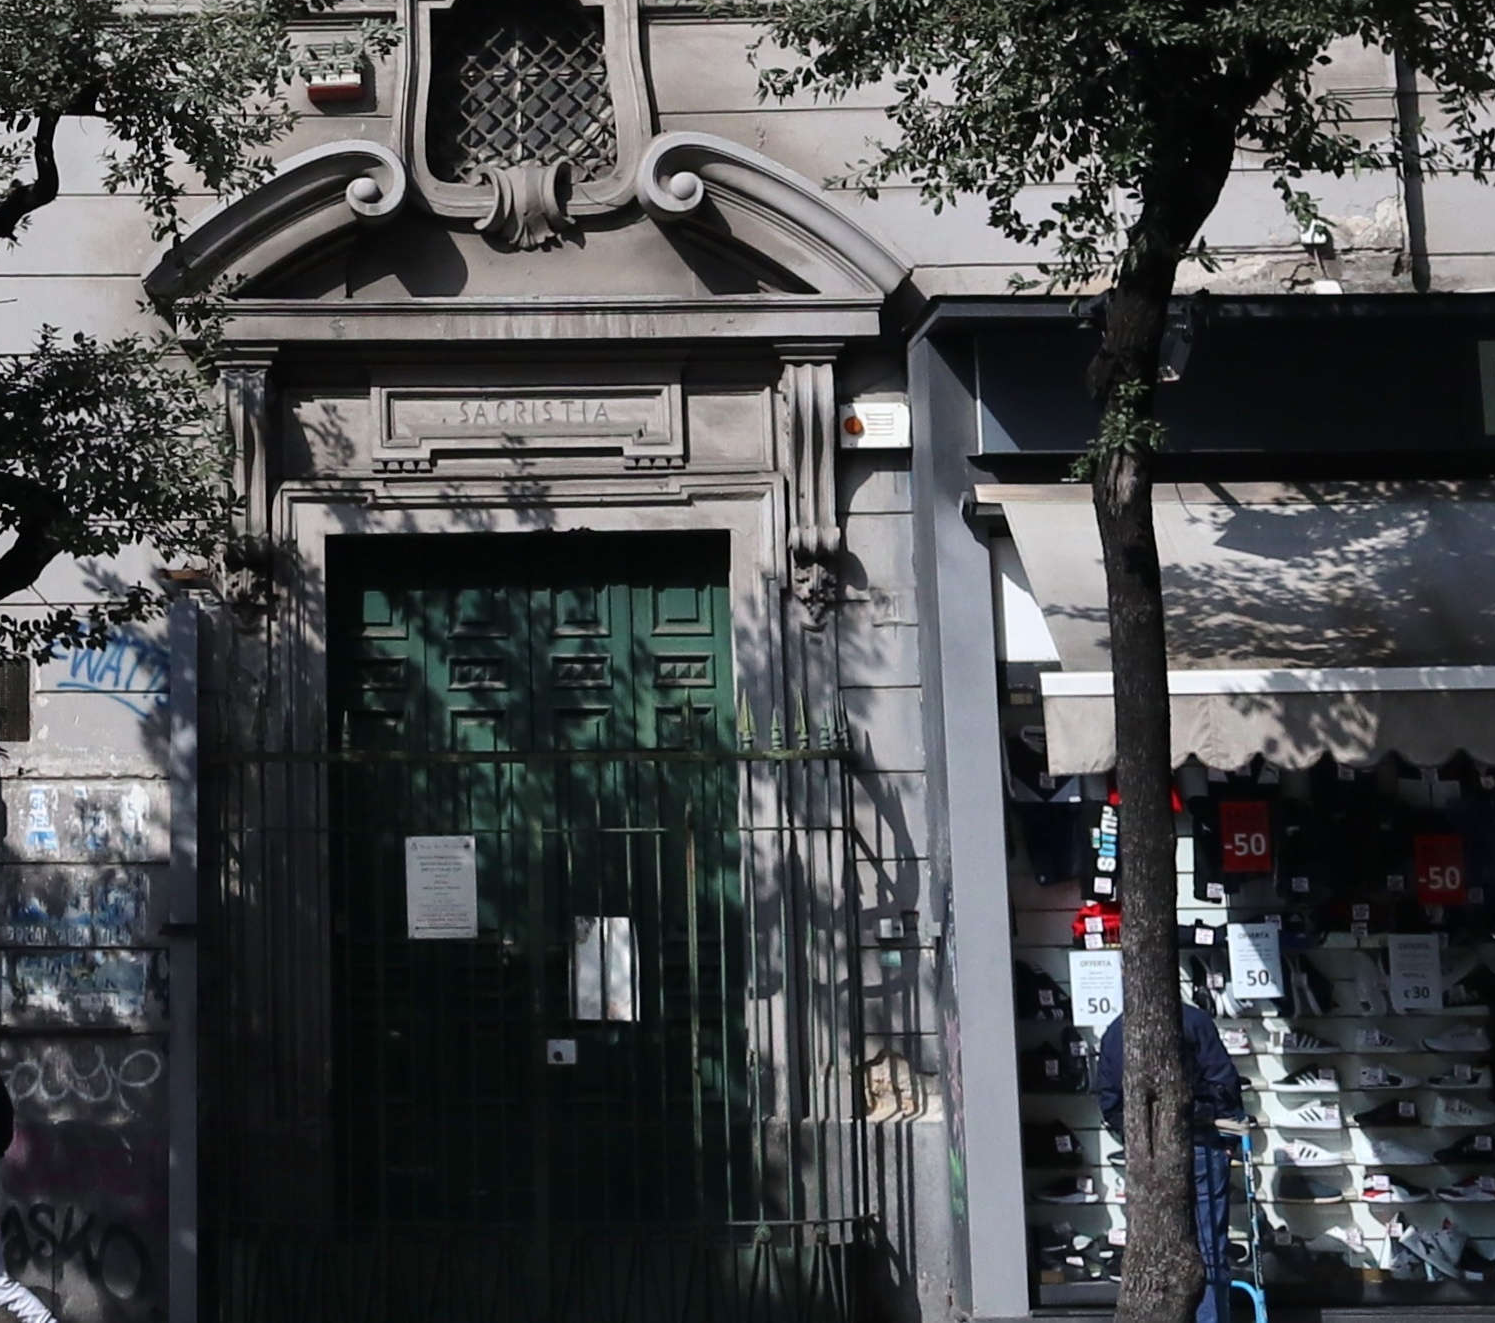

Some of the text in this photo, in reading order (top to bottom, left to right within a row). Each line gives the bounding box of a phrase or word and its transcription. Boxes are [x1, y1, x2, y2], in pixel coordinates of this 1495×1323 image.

[459, 400, 611, 425] SACRISTIA
[1223, 832, 1267, 857] -50
[1417, 865, 1461, 891] -50
[1079, 959, 1112, 968] OFFERTA
